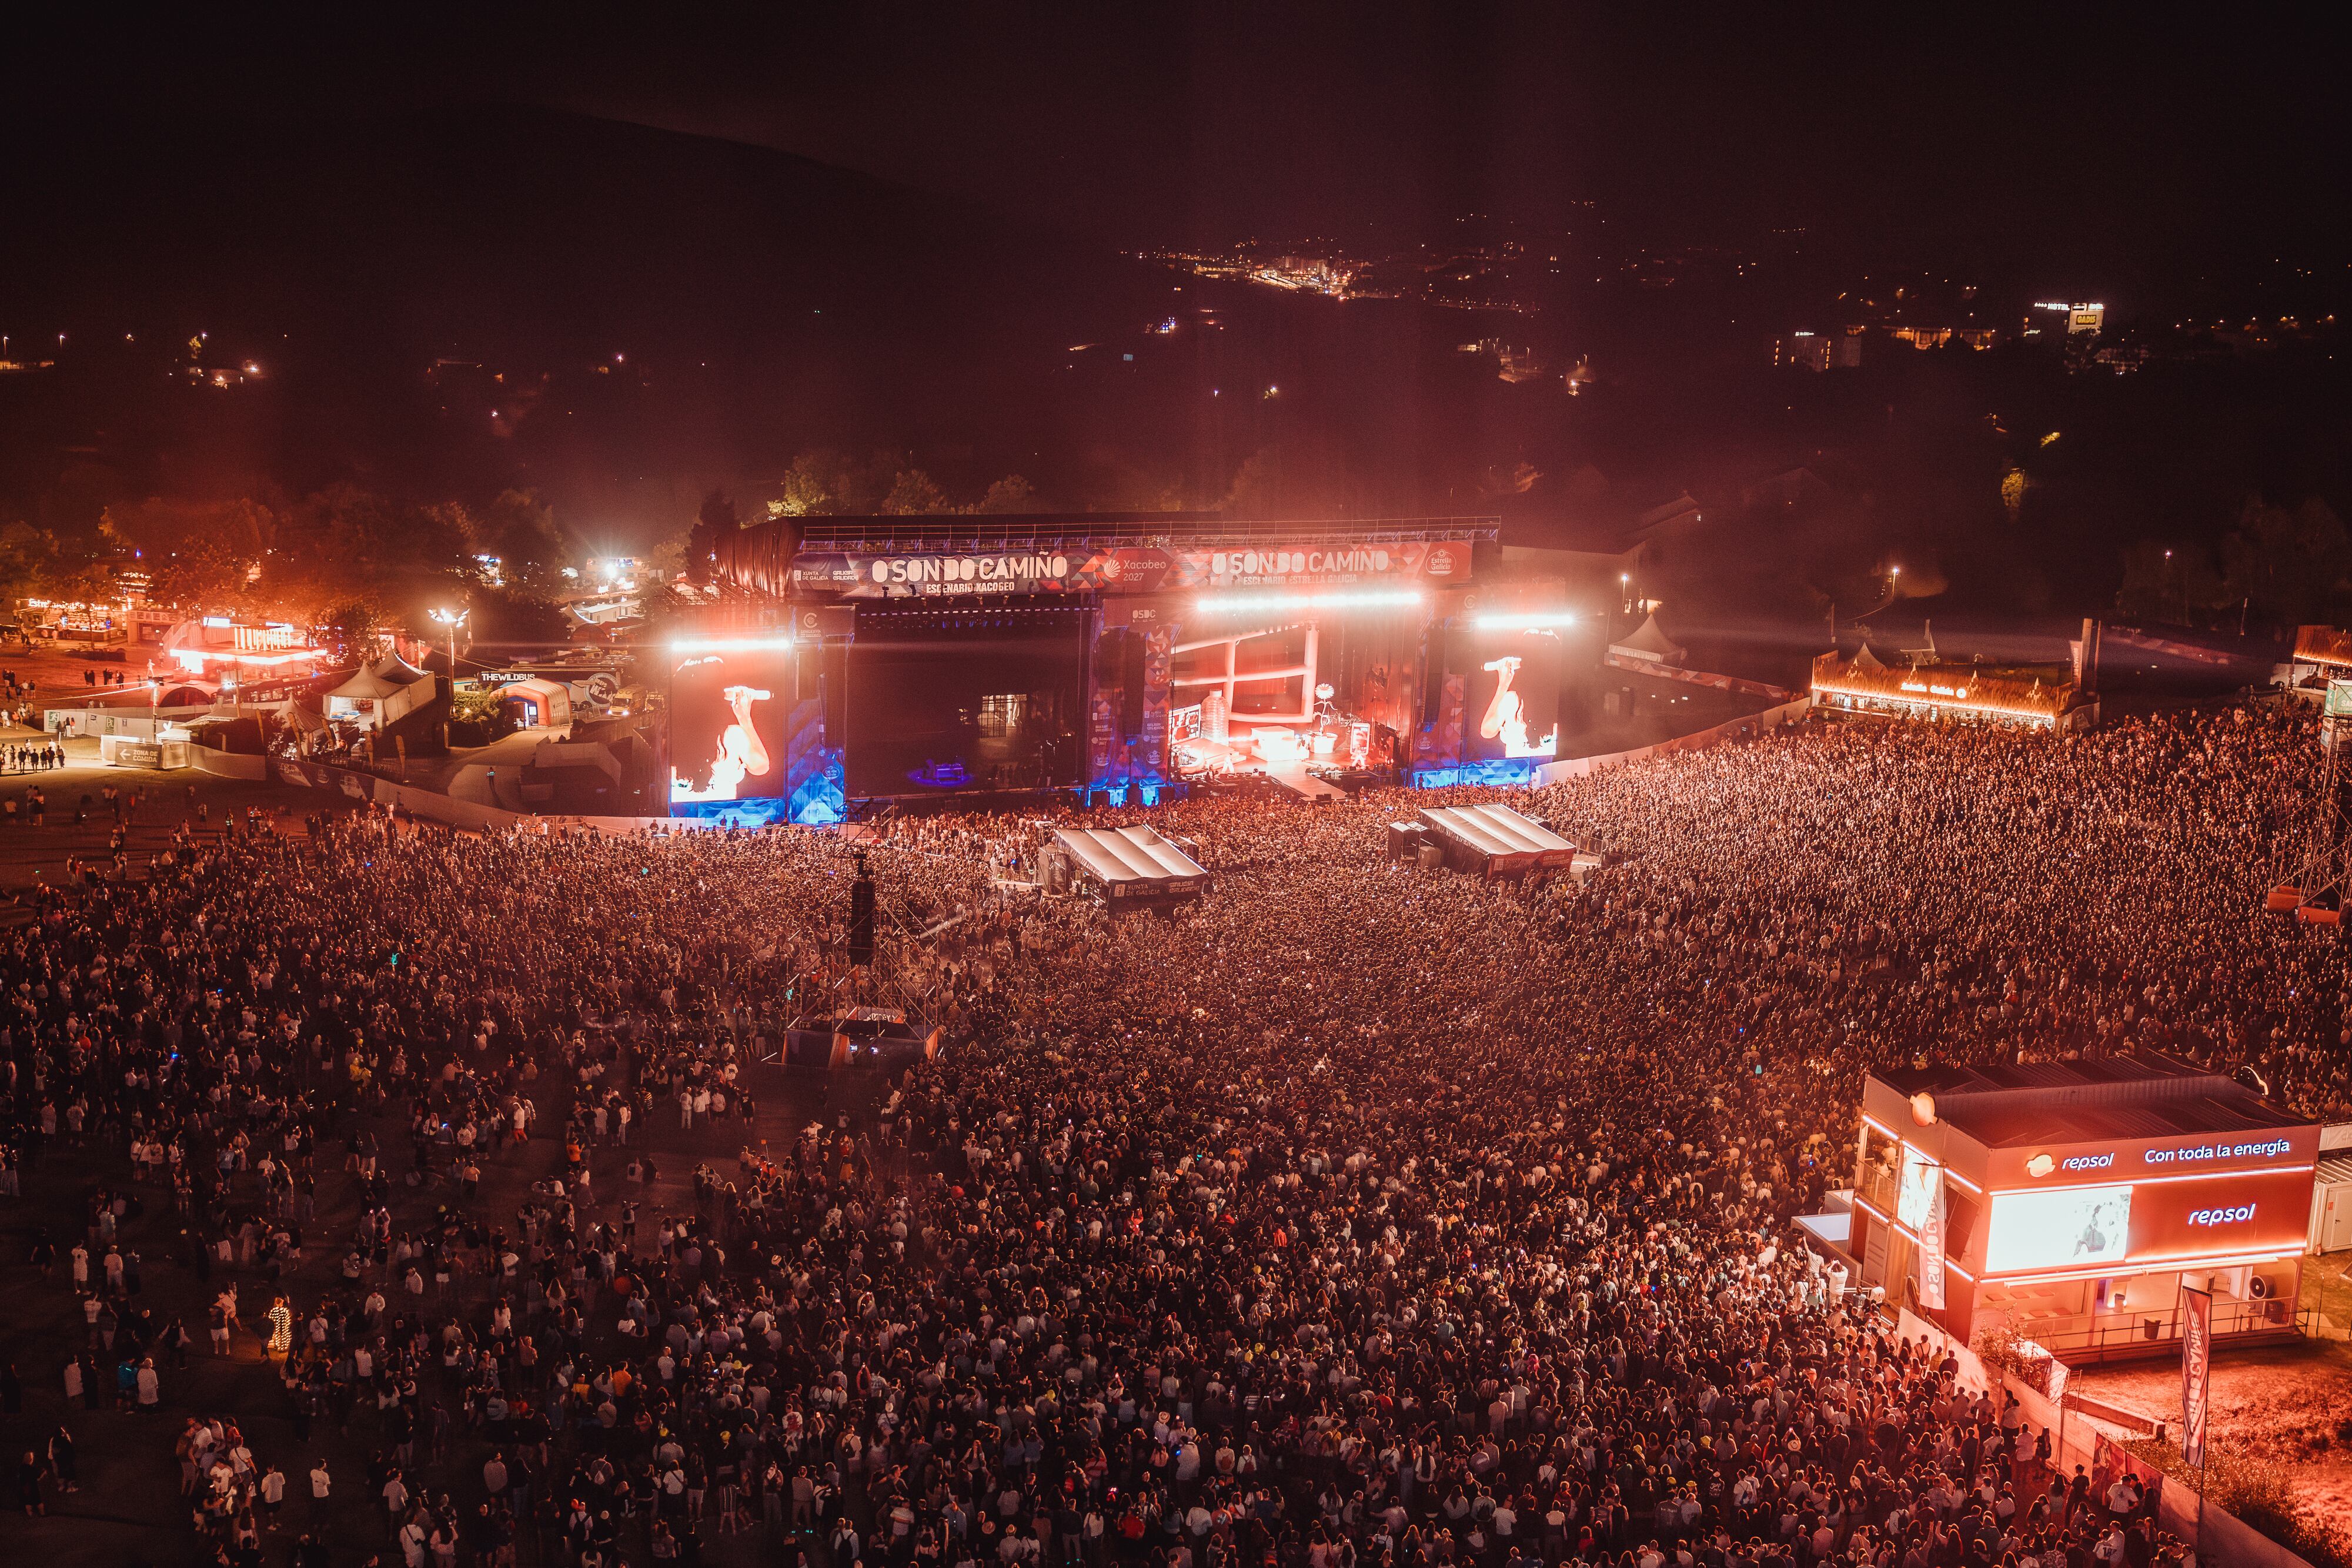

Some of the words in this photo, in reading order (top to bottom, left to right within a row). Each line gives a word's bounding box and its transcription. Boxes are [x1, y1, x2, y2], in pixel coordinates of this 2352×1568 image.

[872, 560, 888, 583] O
[892, 559, 940, 582] SON
[944, 559, 975, 581] DO
[979, 551, 1067, 580] CAMIÑO
[1123, 560, 1166, 570] Xacobeo
[1230, 552, 1272, 574] SON
[1277, 551, 1305, 573] DO
[1123, 573, 1144, 581] 2027
[1327, 574, 1357, 583] GALICIA
[926, 583, 973, 594] ESCENARIO
[2062, 1153, 2114, 1171] repsol
[2144, 1149, 2174, 1163] Con
[2177, 1146, 2214, 1161] toda
[2216, 1144, 2231, 1158] la
[2234, 1138, 2290, 1156] energía
[2188, 1203, 2256, 1226] repsol
